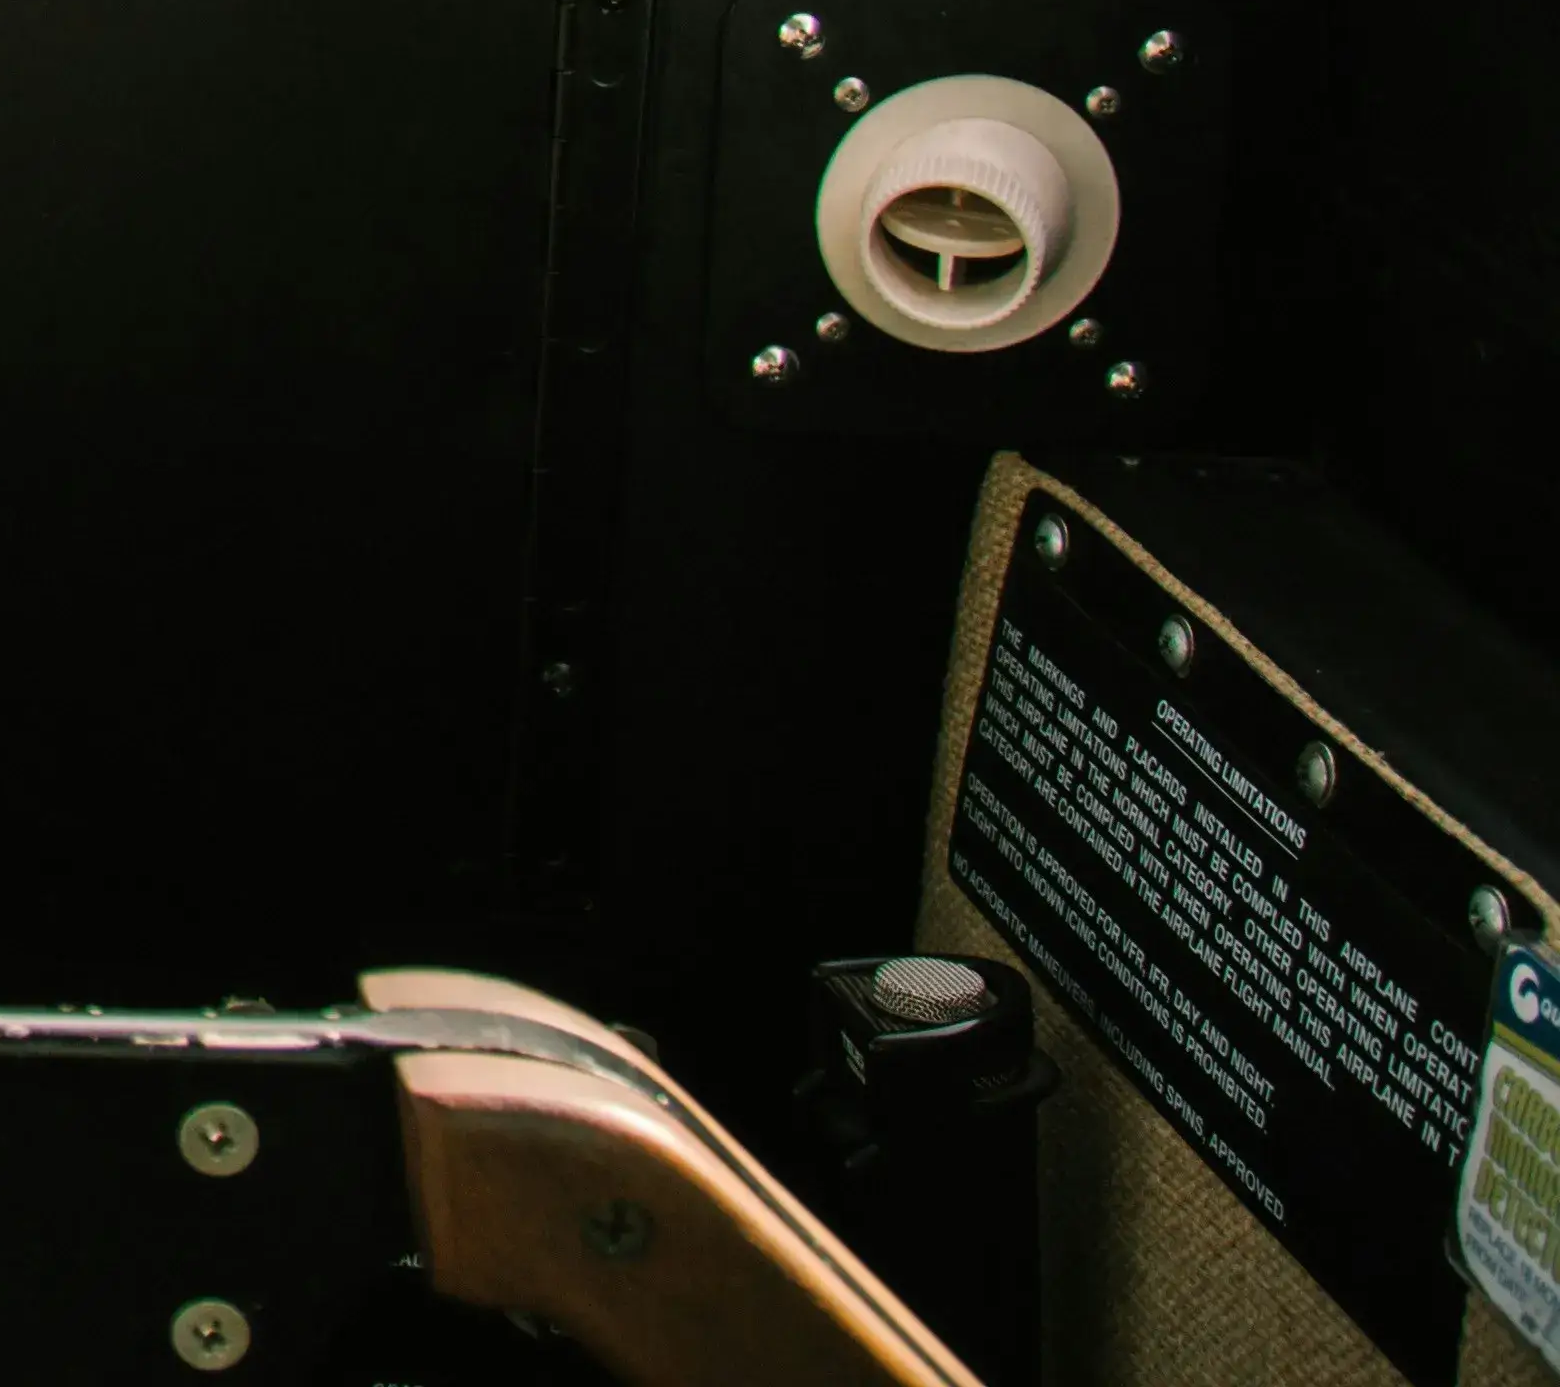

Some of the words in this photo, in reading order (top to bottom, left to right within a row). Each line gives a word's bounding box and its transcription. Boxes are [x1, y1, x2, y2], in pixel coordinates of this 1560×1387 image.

[1001, 616, 1023, 649] THE
[1028, 645, 1086, 709] MARKINGS
[1091, 707, 1119, 739] AND
[1125, 735, 1187, 806] PLACARDS
[1194, 801, 1262, 878] INSTALLED
[1272, 875, 1288, 903] IN
[1299, 898, 1331, 943] THIS
[1341, 940, 1418, 1023] AIRPLANE
[1156, 699, 1221, 772] OPERATING
[1222, 759, 1306, 849] LIMITATIONS
